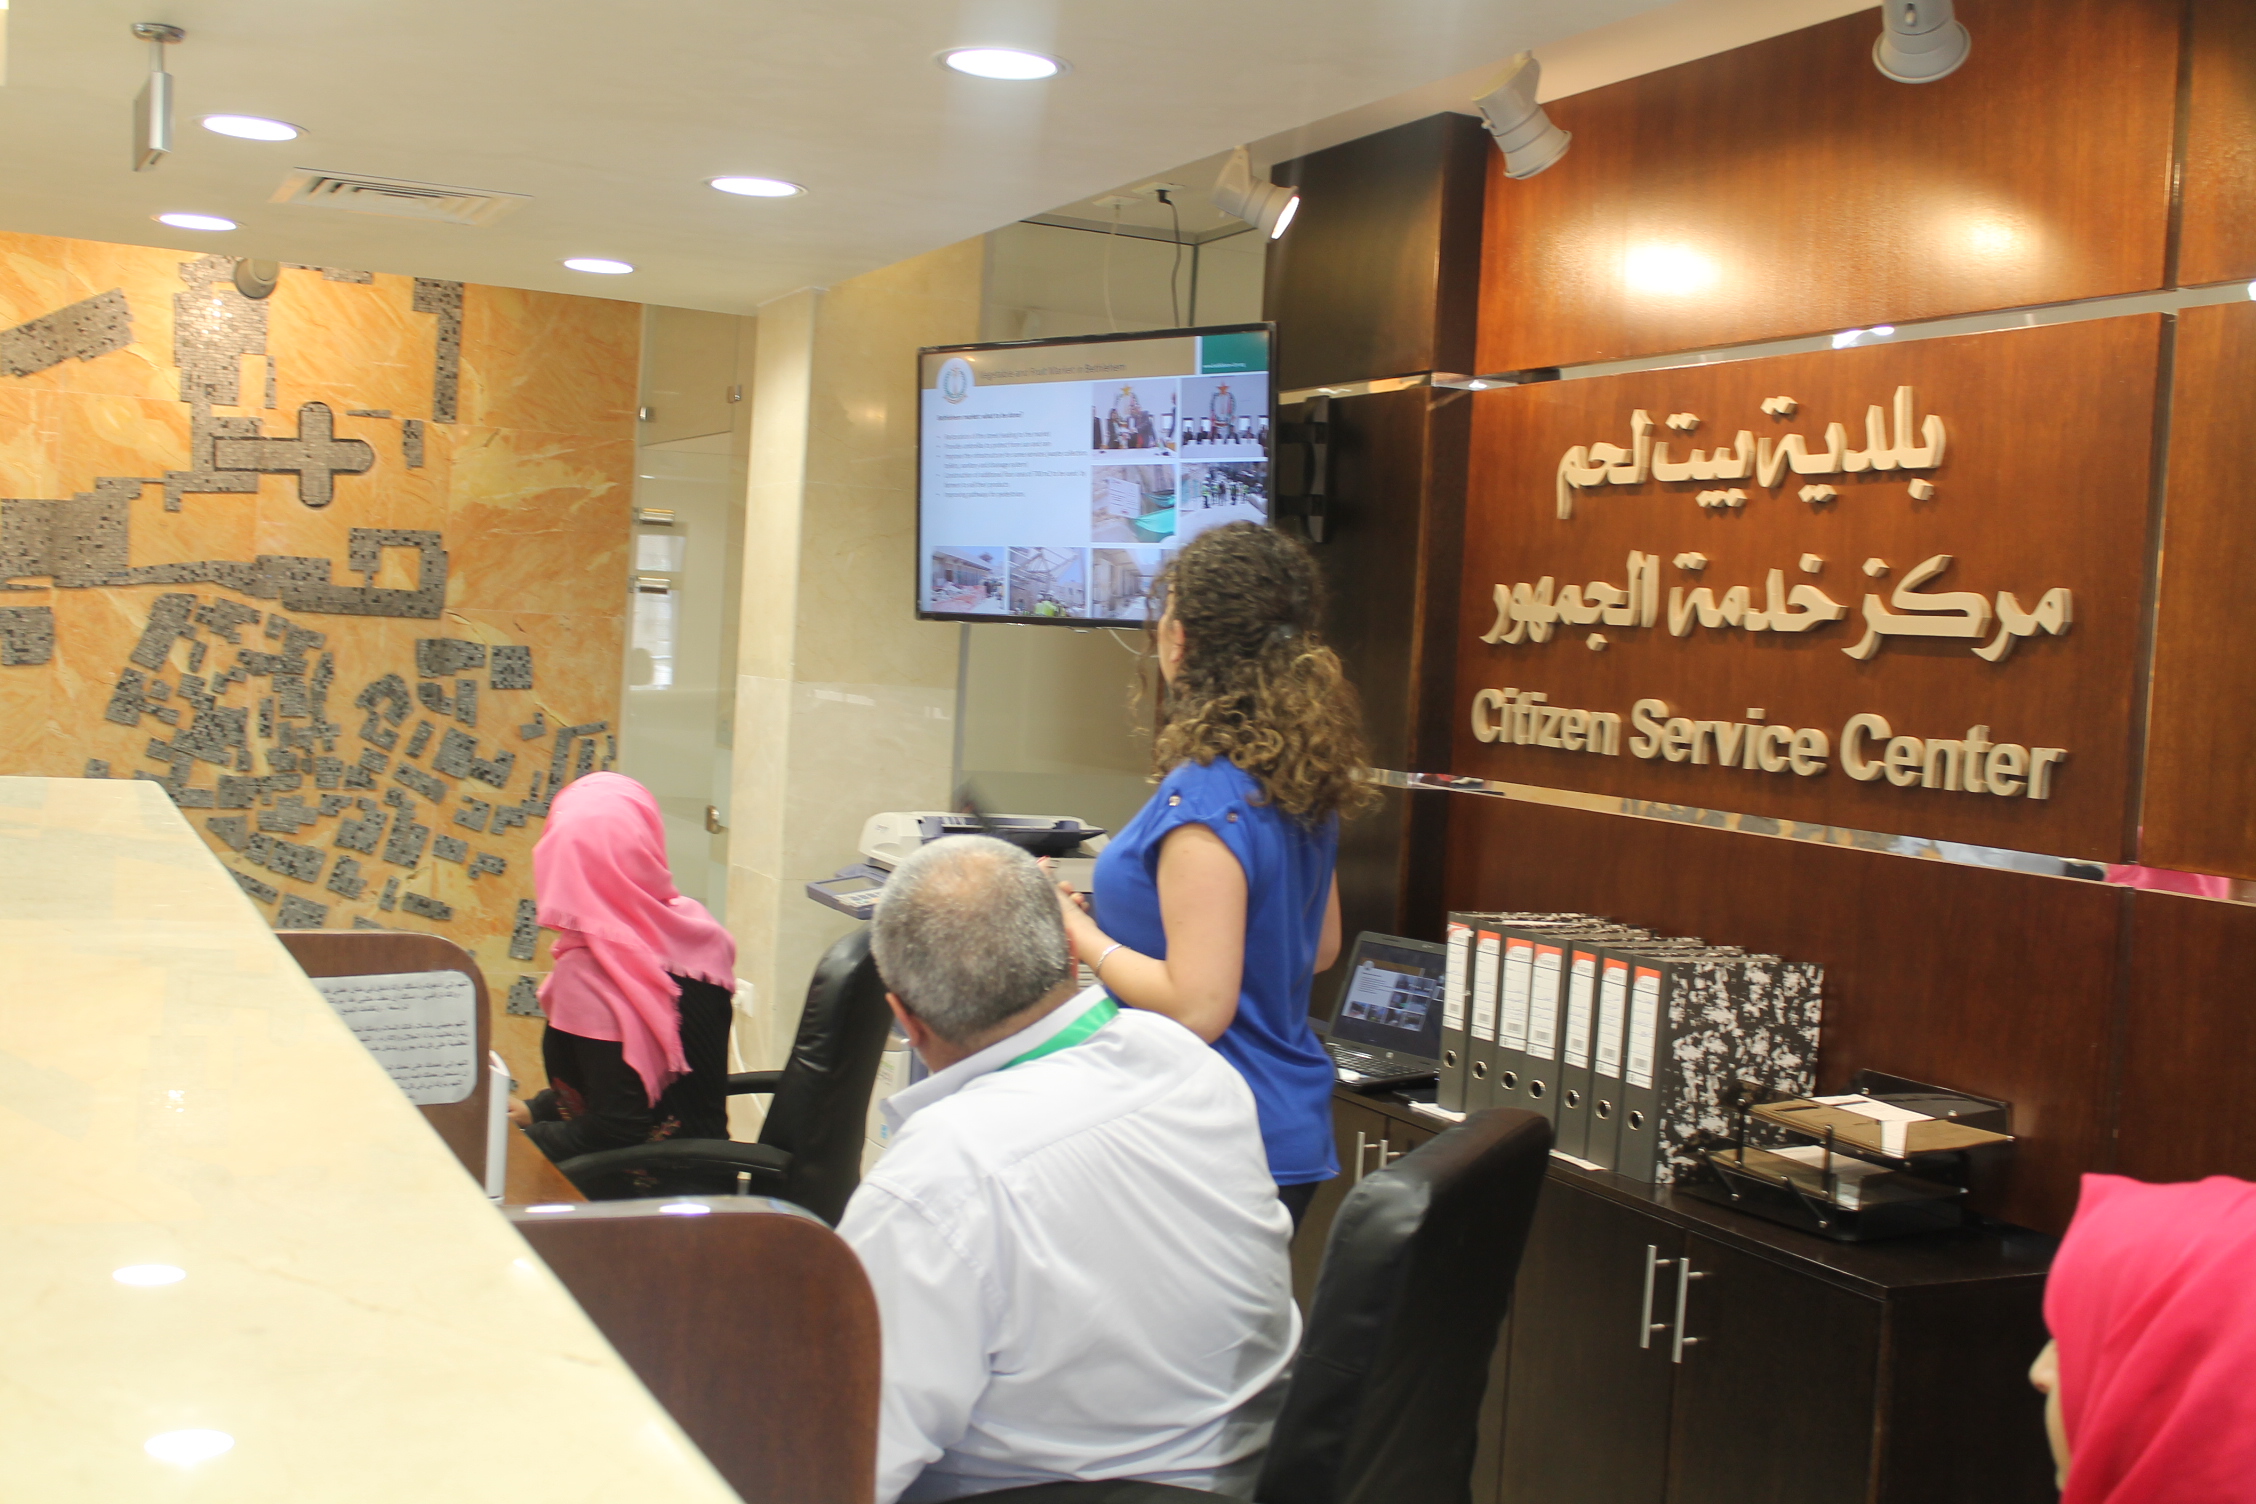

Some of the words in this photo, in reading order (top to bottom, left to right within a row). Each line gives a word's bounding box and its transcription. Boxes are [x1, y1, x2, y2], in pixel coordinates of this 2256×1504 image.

[1556, 408, 1655, 520] لحم
[1651, 412, 1756, 509] بيت
[1756, 386, 1947, 501] بلدية
[1479, 549, 1660, 651] الجمهور
[1667, 552, 1849, 638] خدمة
[1840, 554, 2074, 663] مركز
[1471, 687, 1622, 756] Citizen
[1629, 698, 1830, 777] Service
[1840, 712, 2069, 800] Center
